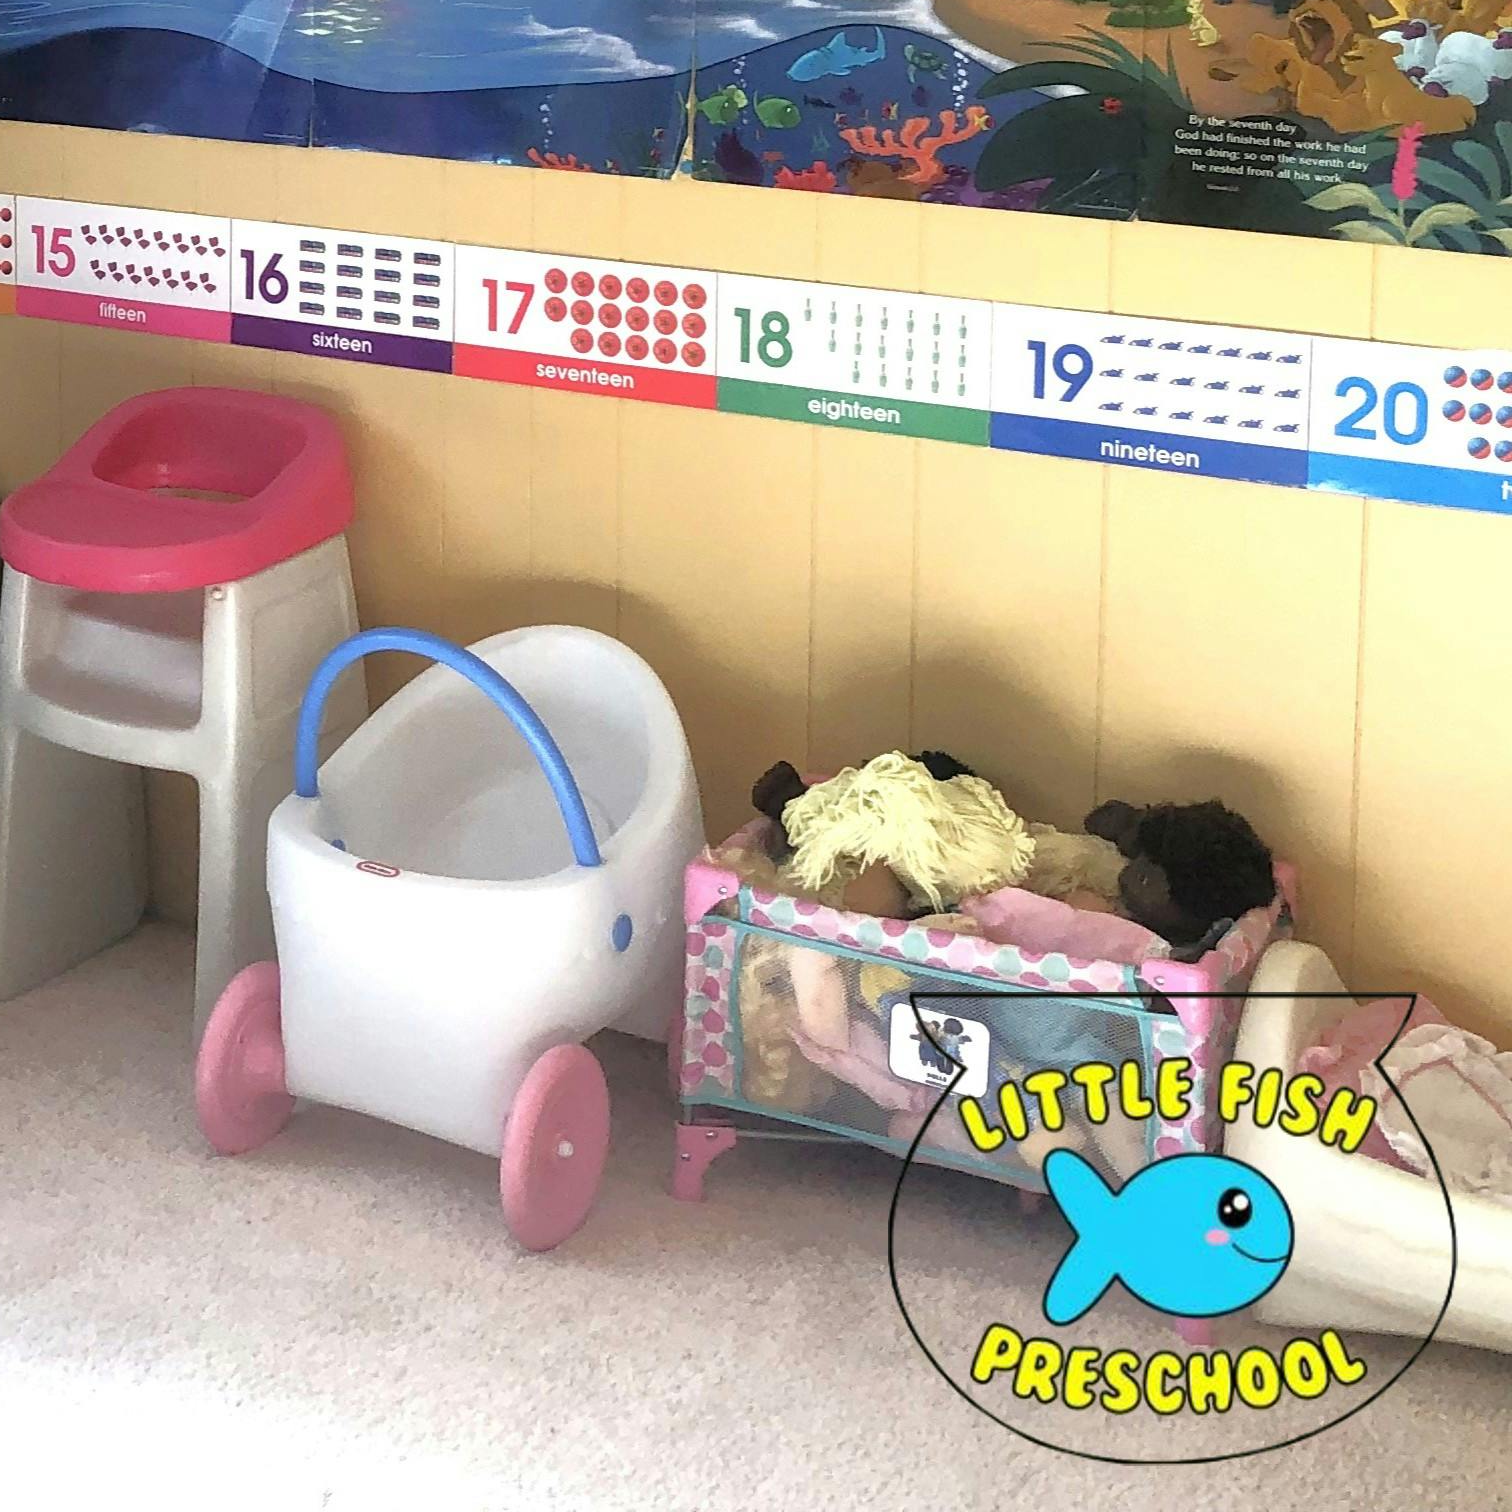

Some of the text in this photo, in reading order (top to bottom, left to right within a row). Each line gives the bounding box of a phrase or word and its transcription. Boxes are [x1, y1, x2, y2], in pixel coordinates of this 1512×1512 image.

[1189, 115, 1204, 127] By
[1208, 117, 1226, 126] the
[1229, 120, 1272, 131] seventh
[1175, 129, 1366, 154] God had finished the work he had
[1175, 145, 1202, 155] been
[1260, 153, 1275, 161] on
[1278, 154, 1296, 163] the
[1299, 157, 1344, 167] seventh
[1347, 159, 1369, 172] day
[1192, 161, 1206, 171] he
[1209, 164, 1244, 175] rested
[1247, 167, 1273, 177] from
[1277, 169, 1290, 178] all
[1294, 170, 1310, 180] his
[31, 224, 76, 278] 15
[240, 249, 289, 304] 16
[99, 301, 146, 324] fifteen
[481, 278, 535, 335] 17
[312, 331, 373, 354] sixteen
[733, 307, 793, 368] 18
[536, 361, 634, 390] seventeen
[1027, 339, 1094, 403] 19
[807, 396, 901, 424] eighteen
[1334, 376, 1429, 445] 20
[1100, 440, 1200, 469] nineteen
